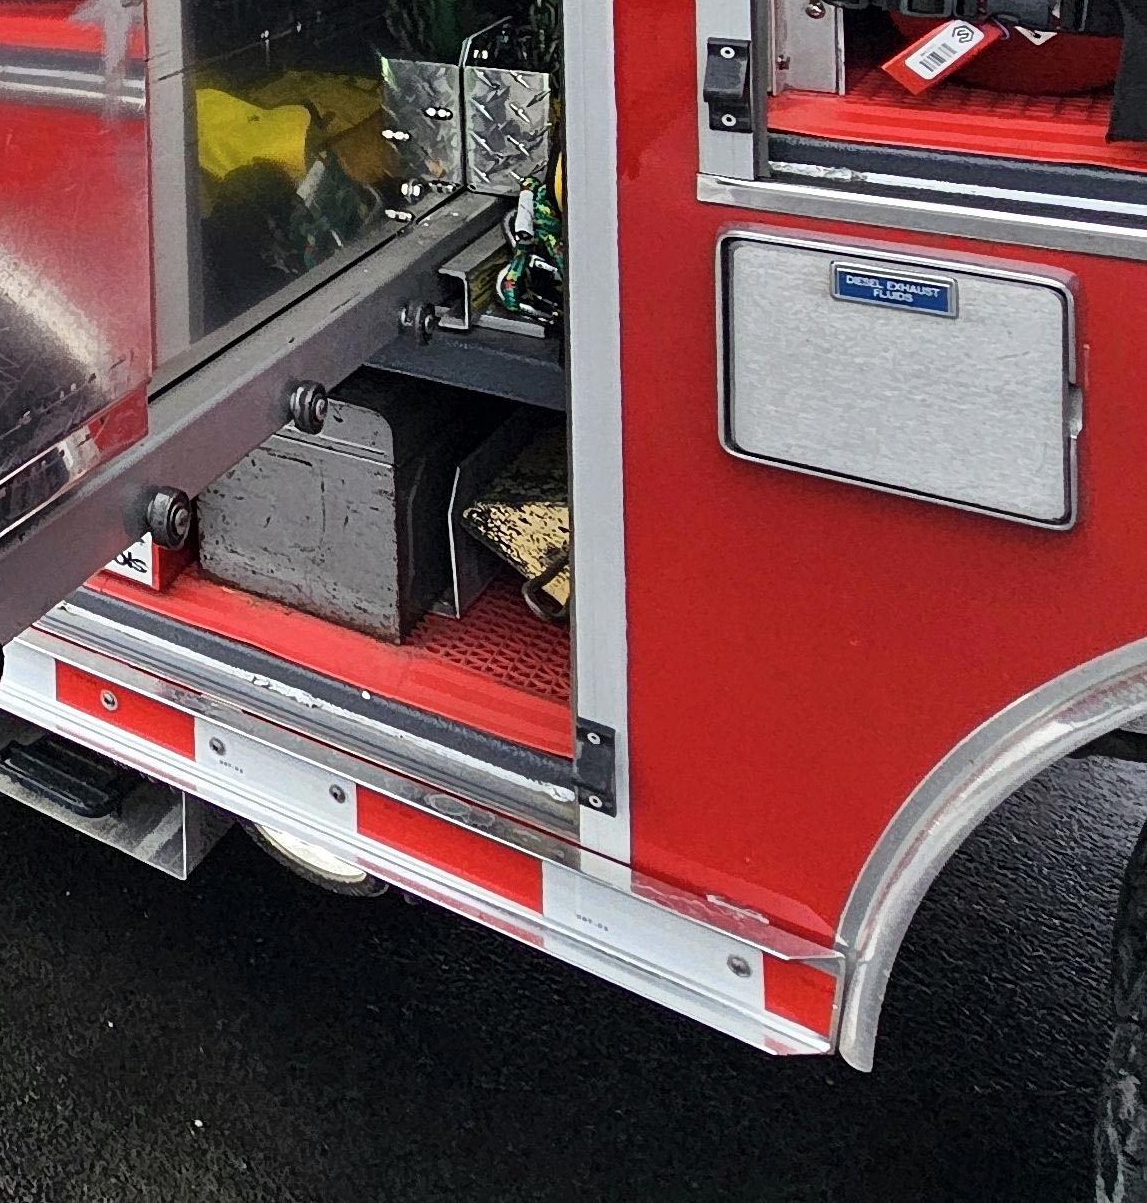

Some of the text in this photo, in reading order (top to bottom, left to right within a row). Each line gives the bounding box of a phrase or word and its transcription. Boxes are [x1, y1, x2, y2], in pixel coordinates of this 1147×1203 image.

[845, 274, 941, 298] DIESEL EXHAUST
[873, 288, 914, 303] FLUIDS
